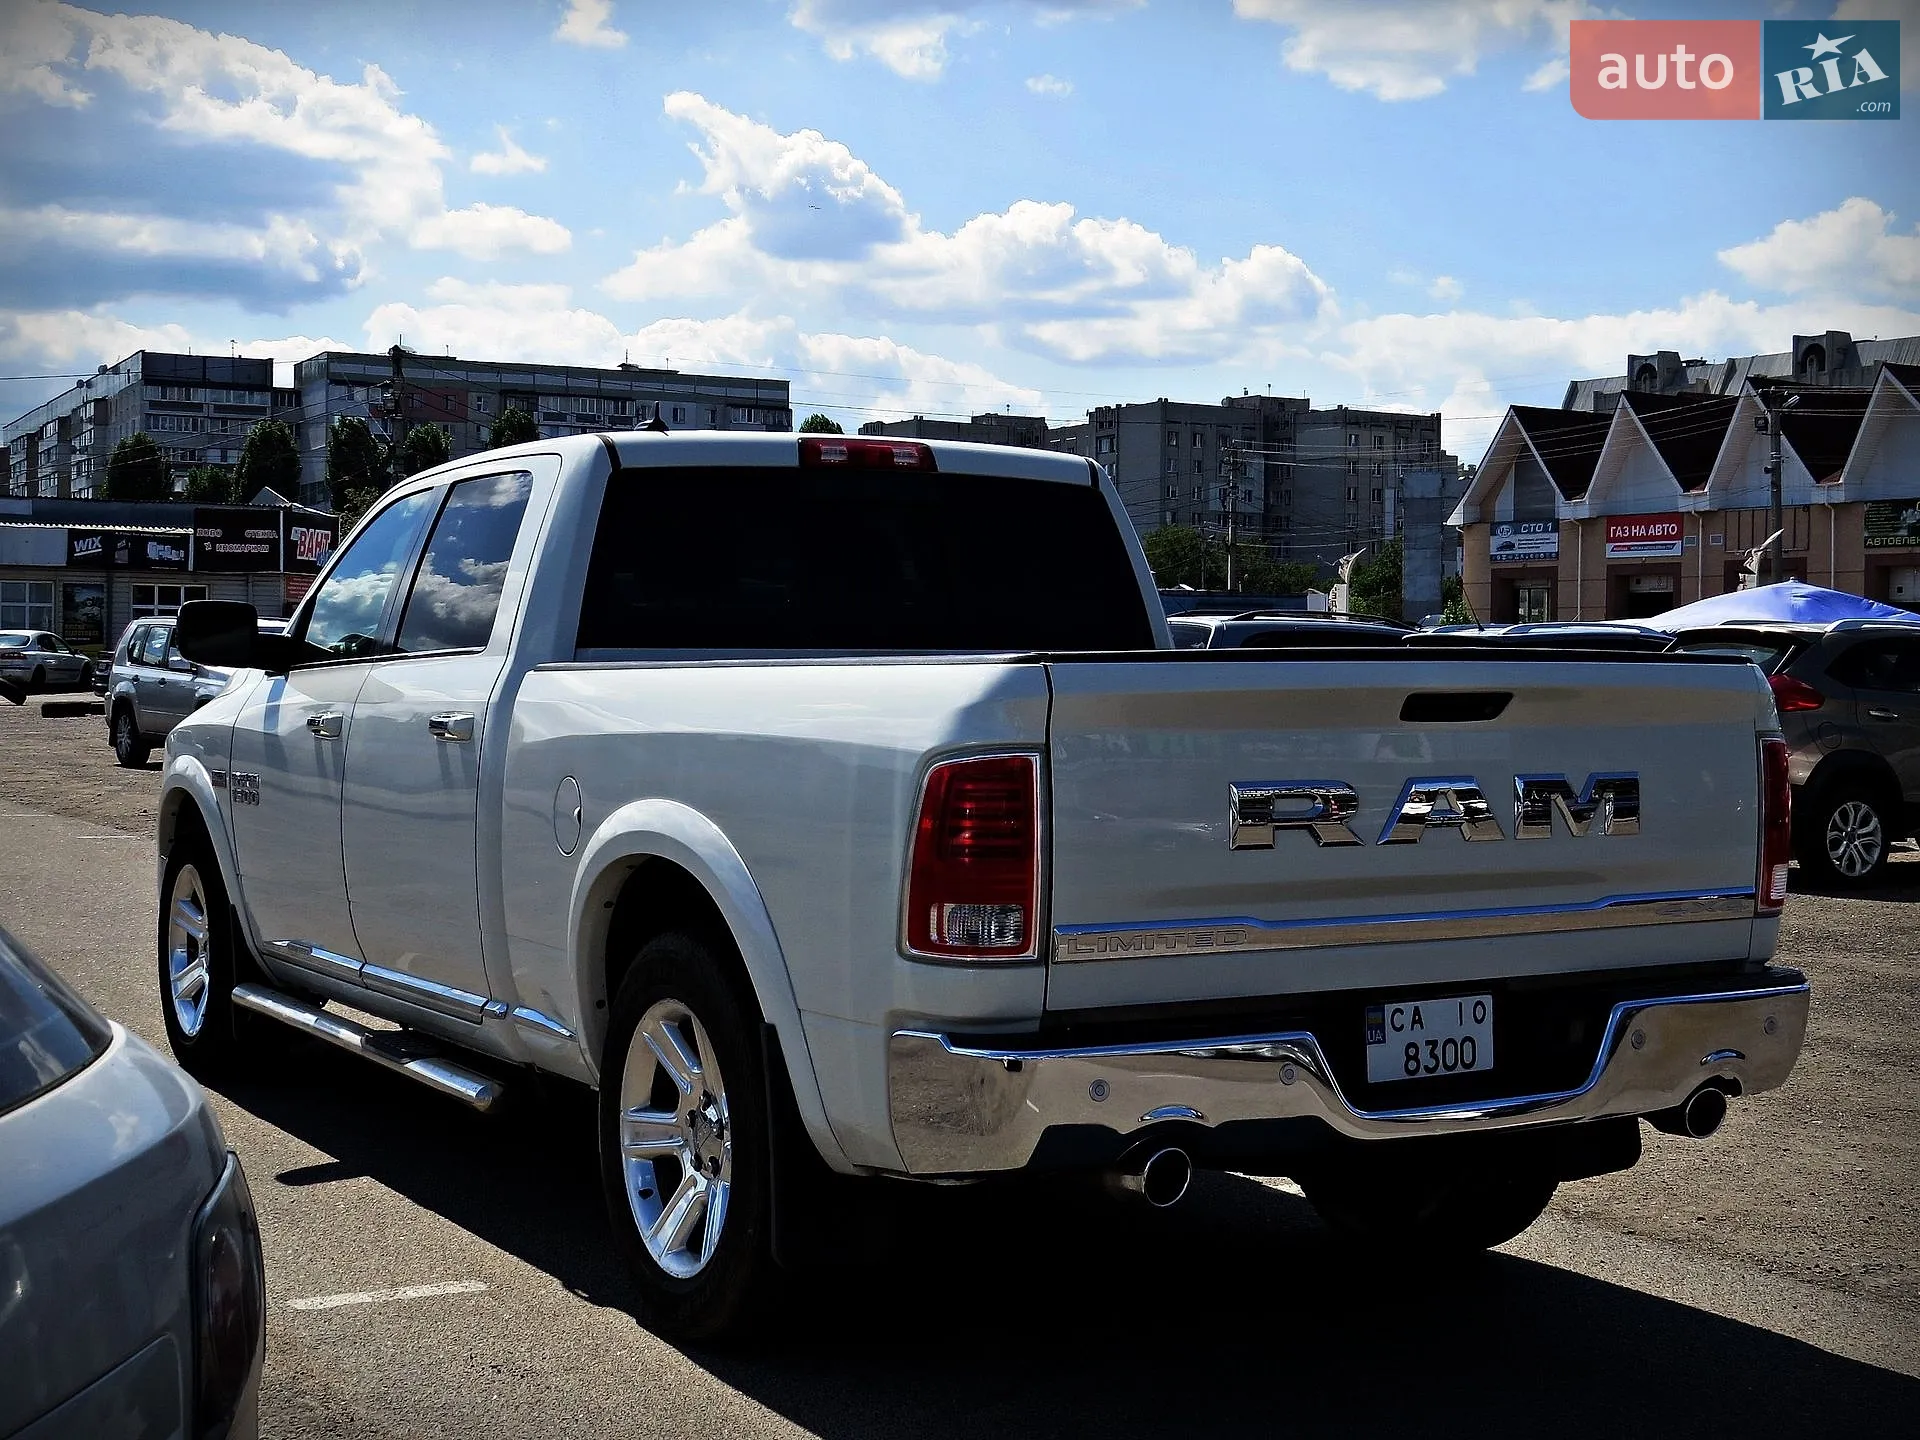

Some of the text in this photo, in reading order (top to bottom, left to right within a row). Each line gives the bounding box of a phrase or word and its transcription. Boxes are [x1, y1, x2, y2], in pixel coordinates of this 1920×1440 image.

[1521, 523, 1543, 533] СТО
[1546, 521, 1553, 532] 1
[1610, 523, 1678, 538] ГАЗ НА АВТО
[74, 535, 103, 553] WIX
[1229, 771, 1641, 851] RAM
[1067, 929, 1248, 955] LIMITED
[1390, 999, 1487, 1033] CA 10
[1367, 1029, 1383, 1042] UA
[1403, 1035, 1477, 1076] 8300
